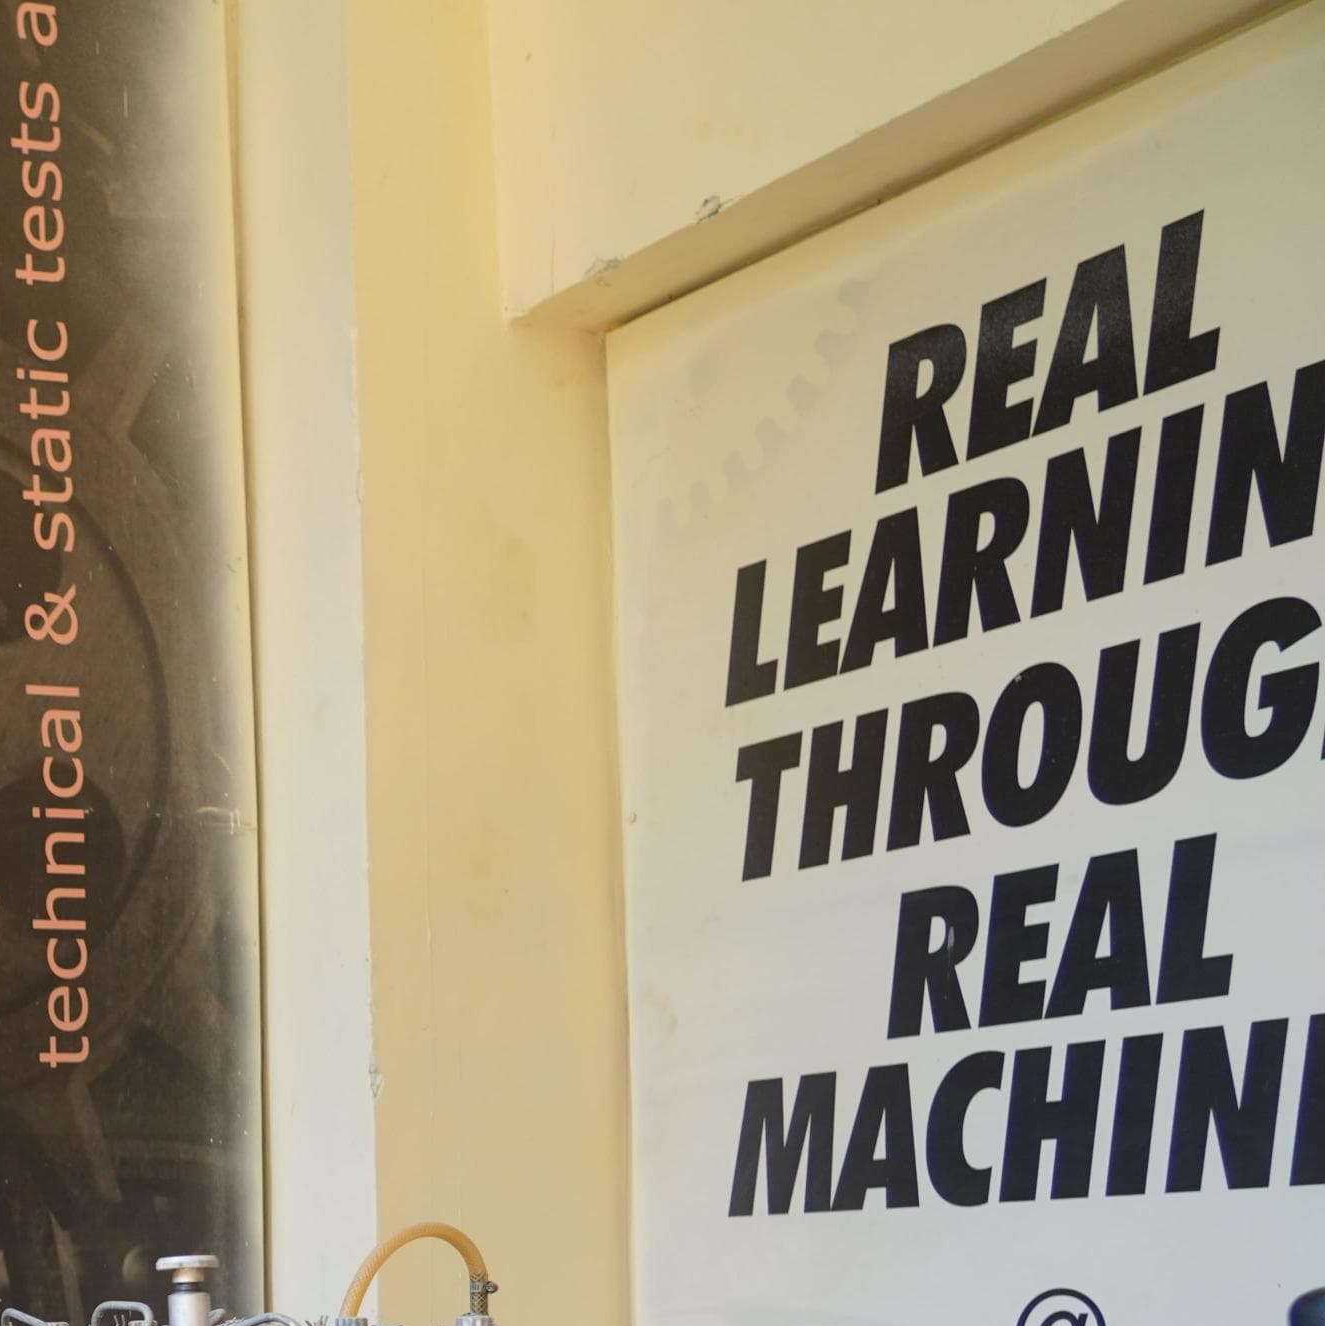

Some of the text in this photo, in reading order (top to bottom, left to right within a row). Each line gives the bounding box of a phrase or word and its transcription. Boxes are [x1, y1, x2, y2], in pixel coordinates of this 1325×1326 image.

[10, 81, 66, 285] tests
[16, 319, 75, 553] static
[875, 209, 1221, 495] REAL
[24, 584, 79, 645] &
[725, 359, 1325, 707] LEARNIN
[735, 596, 1325, 882] THROUG
[25, 684, 89, 1067] technical
[887, 833, 1234, 1041] REAL
